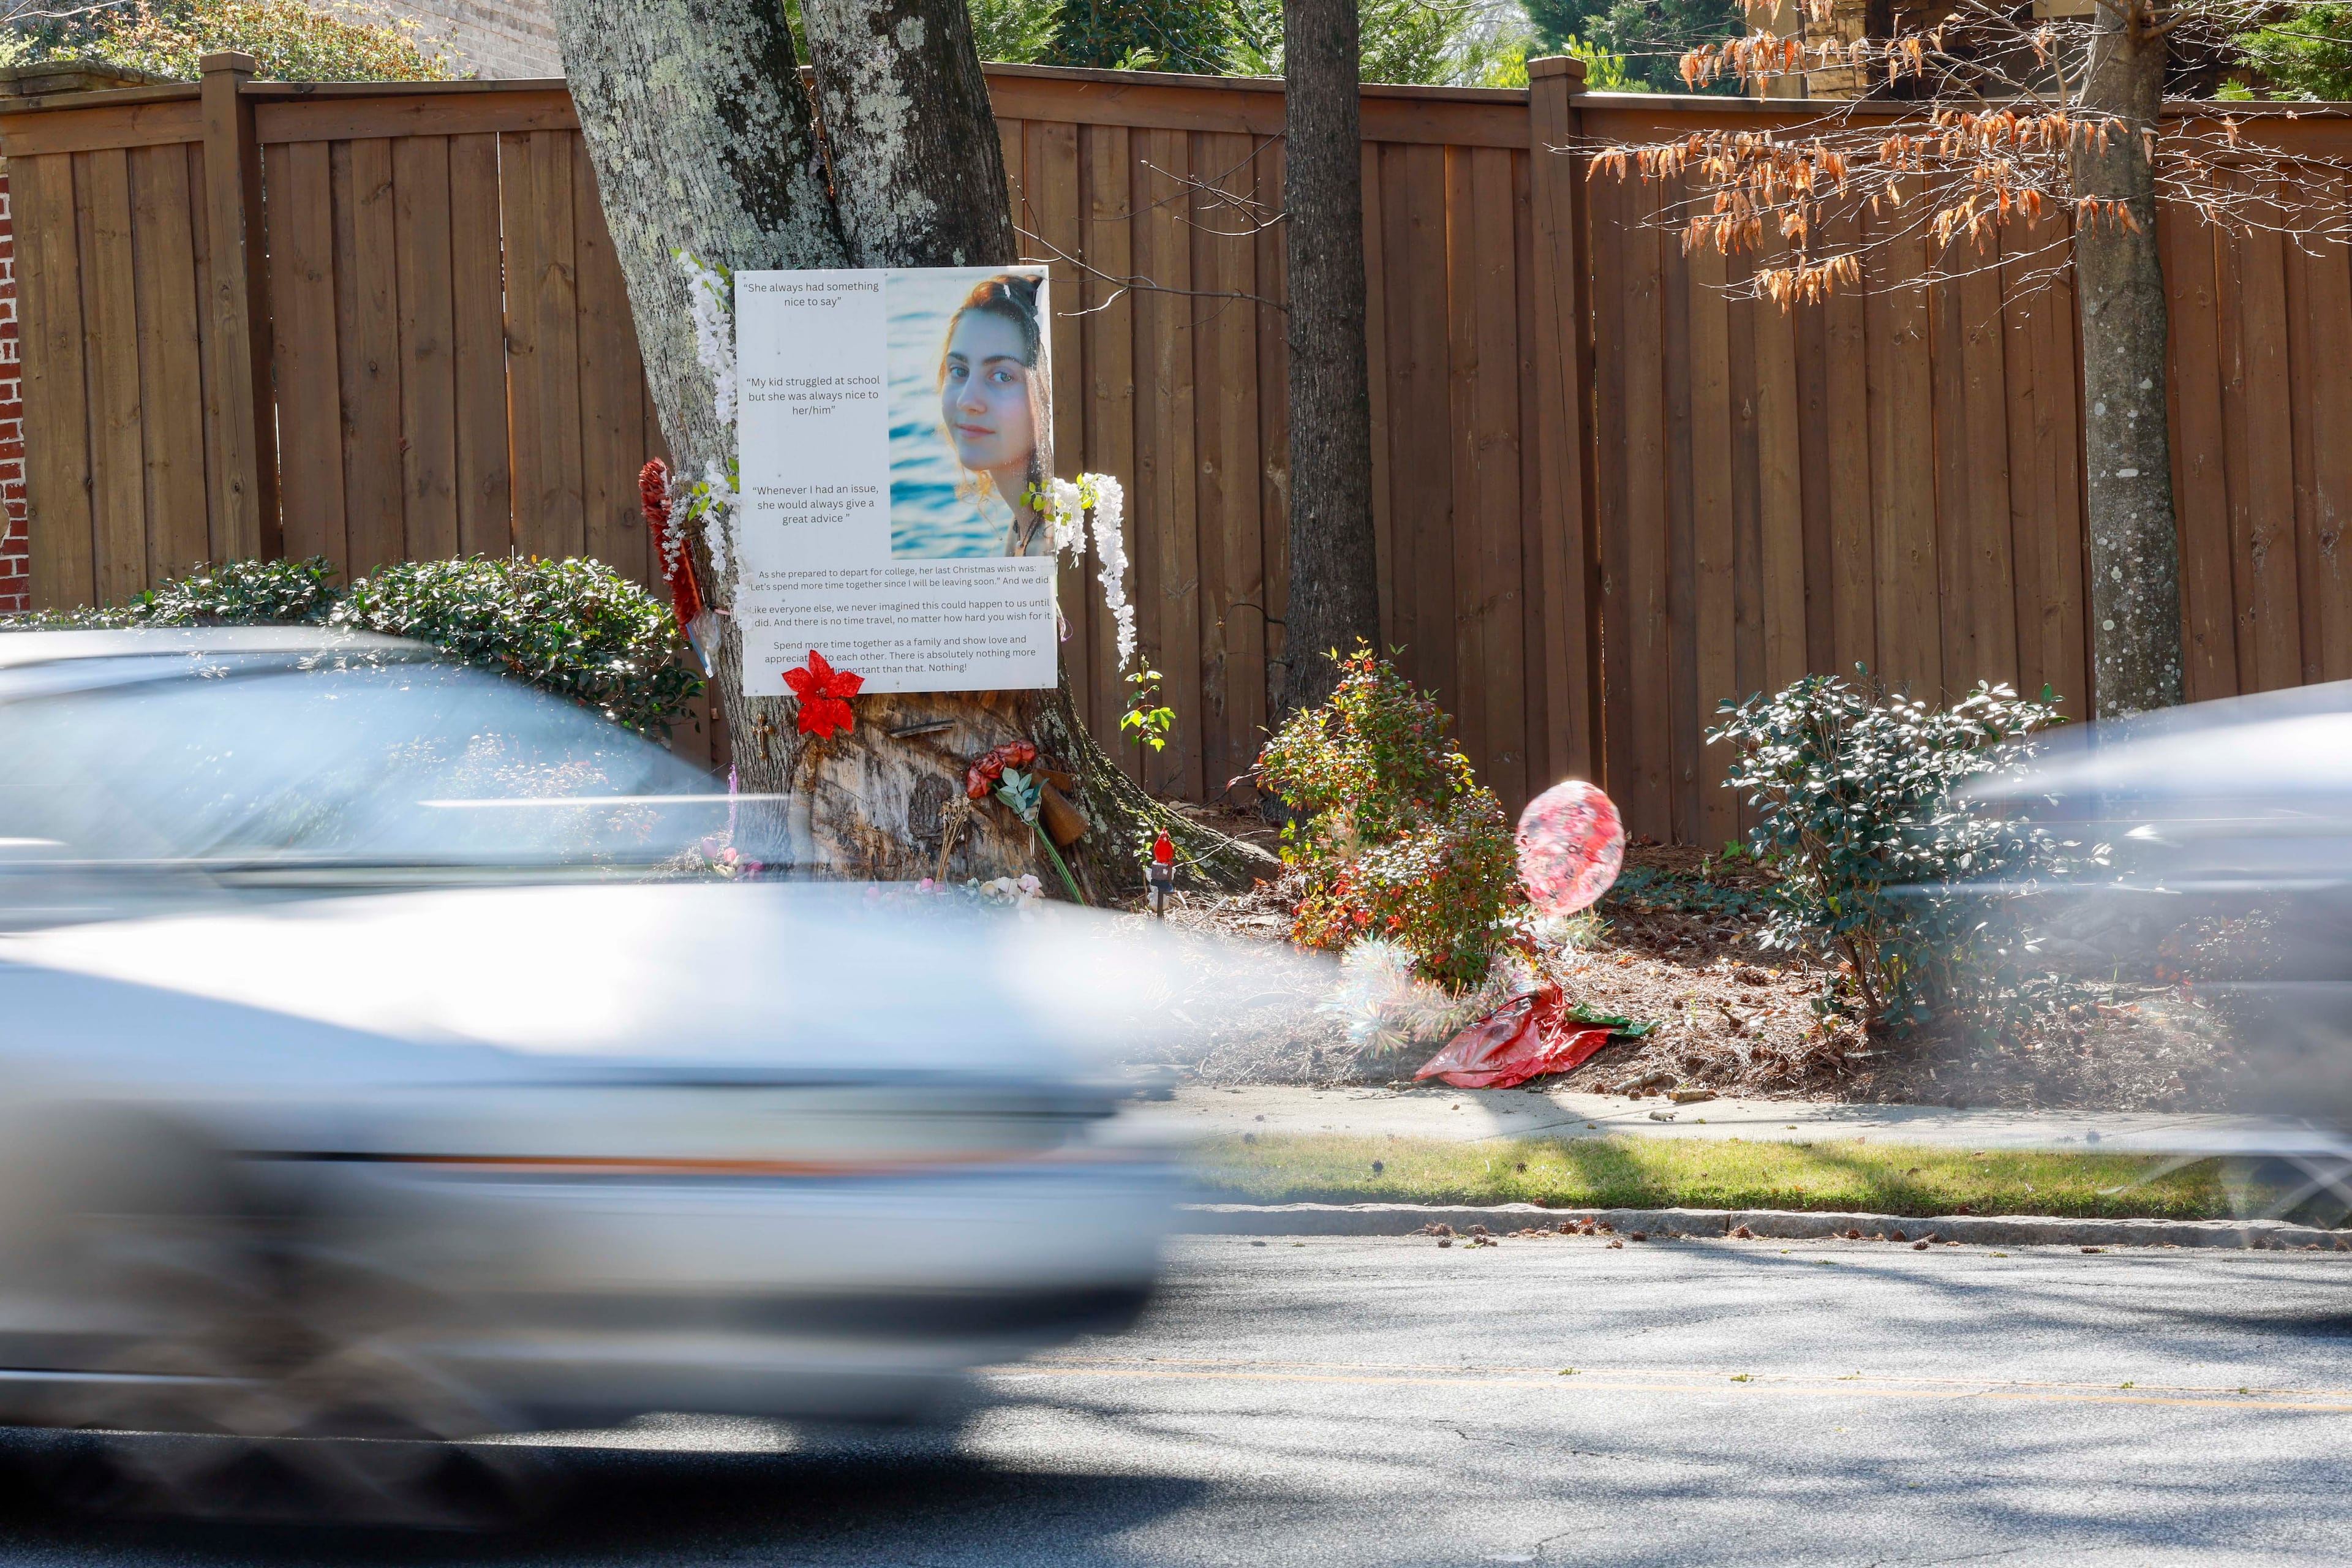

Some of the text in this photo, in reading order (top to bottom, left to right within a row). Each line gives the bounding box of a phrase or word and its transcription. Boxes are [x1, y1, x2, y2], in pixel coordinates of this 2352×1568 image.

[769, 282, 803, 294] always
[805, 282, 824, 292] had
[826, 281, 880, 293] something
[784, 297, 805, 307] nice
[807, 298, 818, 306] to
[769, 377, 783, 386] kid
[785, 375, 832, 388] struggled
[834, 377, 845, 385] at
[847, 375, 880, 385] school
[748, 392, 766, 402] but
[767, 391, 786, 401] she
[809, 391, 843, 402] always
[845, 390, 866, 400] nice
[867, 391, 879, 399] to
[815, 484, 834, 494] had
[851, 484, 879, 494] issue,
[757, 500, 775, 510] she
[777, 499, 807, 510] would
[810, 499, 844, 510] always
[846, 498, 867, 510] give
[782, 515, 809, 526] great
[810, 513, 843, 523] advice
[788, 569, 827, 580] prepared
[840, 568, 869, 578] depart
[884, 567, 917, 577] college,
[935, 566, 951, 575] last
[952, 565, 995, 574] Christmas
[997, 564, 1016, 573] wish
[772, 582, 799, 592] spend
[824, 581, 844, 589] time
[845, 580, 883, 590] together
[884, 579, 907, 588] since
[913, 579, 927, 587] will
[929, 578, 940, 587] be
[942, 578, 973, 588] leaving
[1002, 576, 1019, 585] And
[1035, 576, 1051, 584] did.
[769, 606, 812, 616] everyone
[813, 604, 834, 614] else,
[879, 601, 920, 612] imagined
[922, 601, 939, 610] this
[941, 600, 967, 609] could
[968, 600, 1003, 611] happen
[1029, 598, 1050, 607] until
[754, 618, 772, 627] did.
[774, 617, 792, 627] And
[794, 617, 819, 627] there
[821, 617, 828, 625] is
[843, 616, 864, 625] time
[866, 615, 895, 625] travel,
[943, 614, 963, 623] how
[965, 612, 986, 622] hard
[987, 614, 1005, 624] you
[1006, 612, 1027, 621] wish
[1028, 611, 1042, 620] for
[1044, 611, 1053, 620] it.
[774, 641, 802, 652] Spend
[830, 639, 851, 649] time
[853, 638, 892, 650] together
[913, 637, 942, 647] family
[943, 636, 960, 646] and
[962, 636, 987, 645] show
[989, 635, 1008, 644] love
[1009, 635, 1027, 644] and
[824, 654, 835, 662] to
[836, 652, 858, 662] each
[860, 652, 888, 661] other.
[889, 651, 915, 660] There
[917, 651, 925, 660] is
[926, 649, 974, 660] absolutely
[976, 648, 1011, 659] nothing
[882, 665, 903, 673] than
[905, 664, 926, 673] that.
[929, 663, 967, 673] Nothing!
